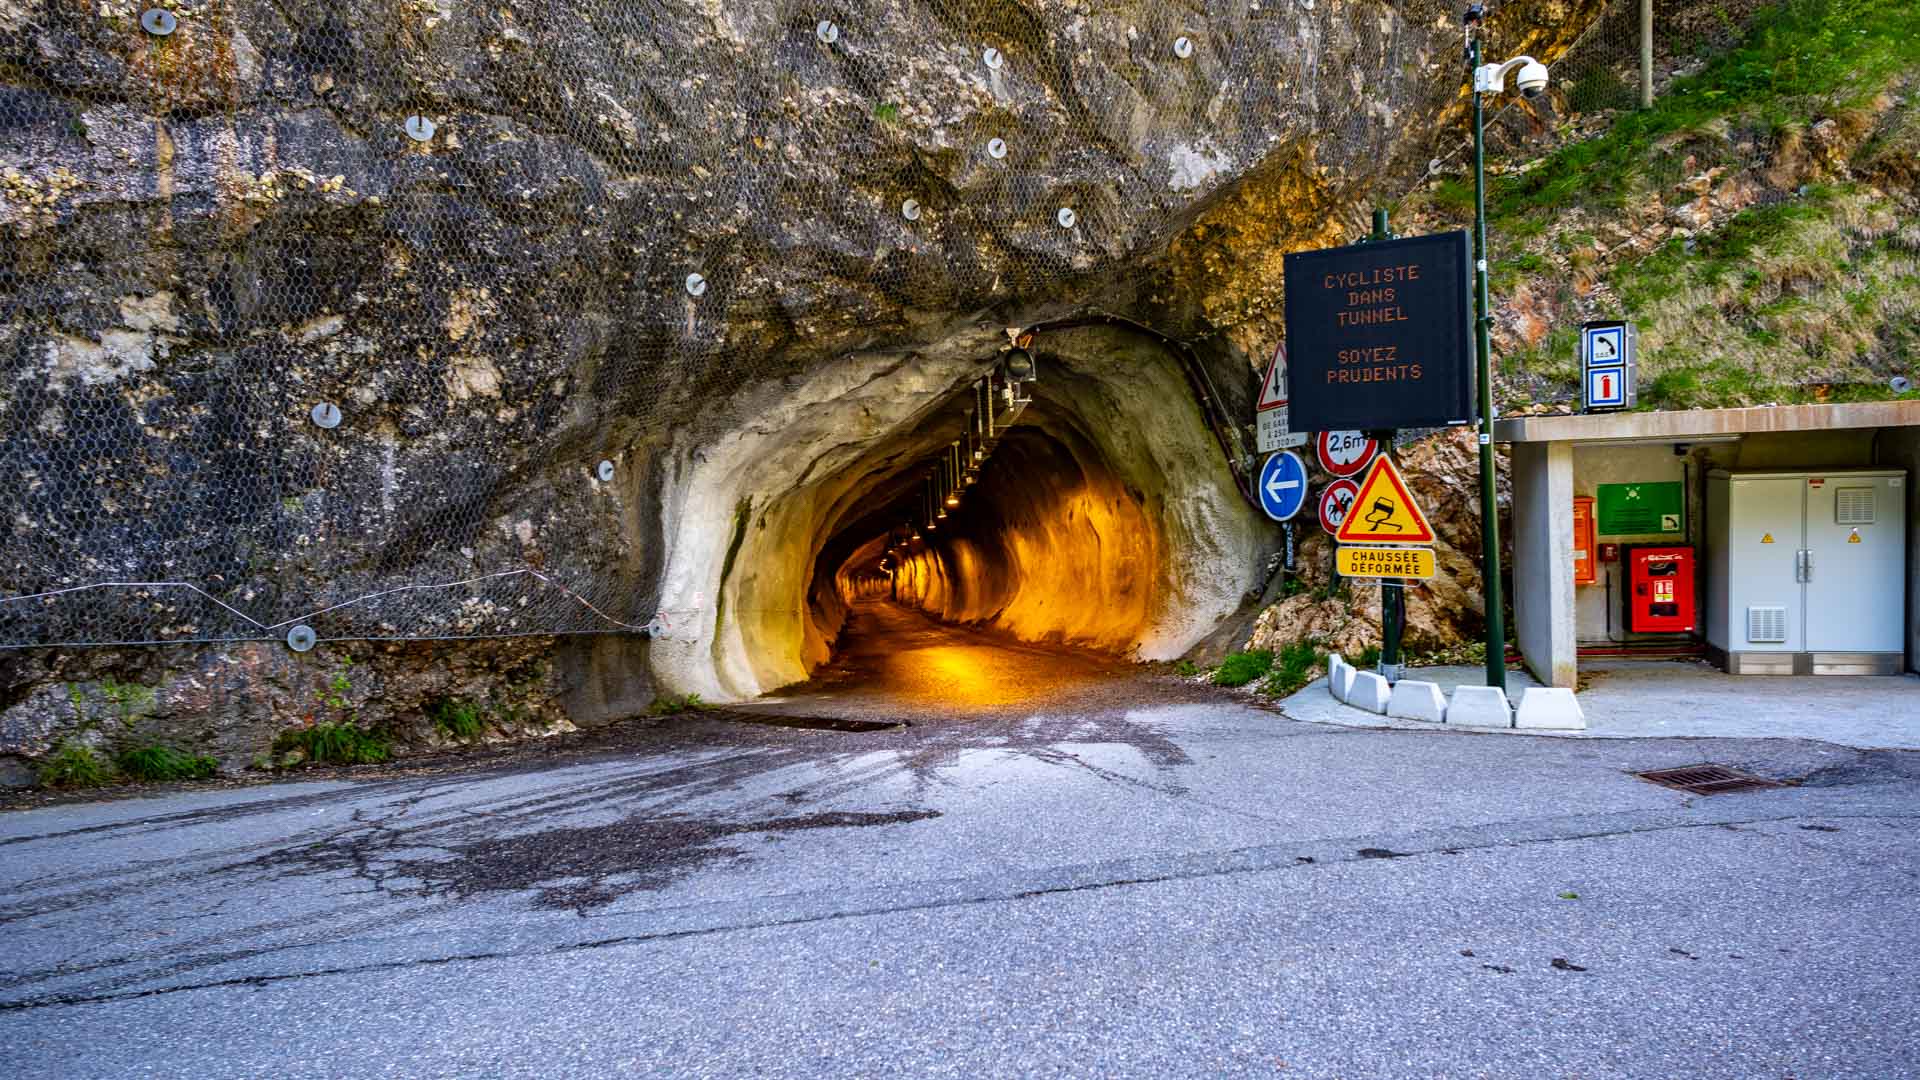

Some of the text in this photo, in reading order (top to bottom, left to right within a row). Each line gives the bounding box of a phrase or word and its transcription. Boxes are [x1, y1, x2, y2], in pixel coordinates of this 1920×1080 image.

[1325, 265, 1420, 288] CYCLISTE
[1348, 288, 1395, 306] DANS
[1337, 307, 1408, 327] TUNNEL
[1338, 347, 1396, 364] SOYEZ
[1327, 364, 1422, 384] PRUDENTS
[1330, 434, 1366, 453] 2,6m
[1352, 551, 1419, 563] CHAUSSÉE
[1351, 562, 1421, 575] DÉFORMÉE
